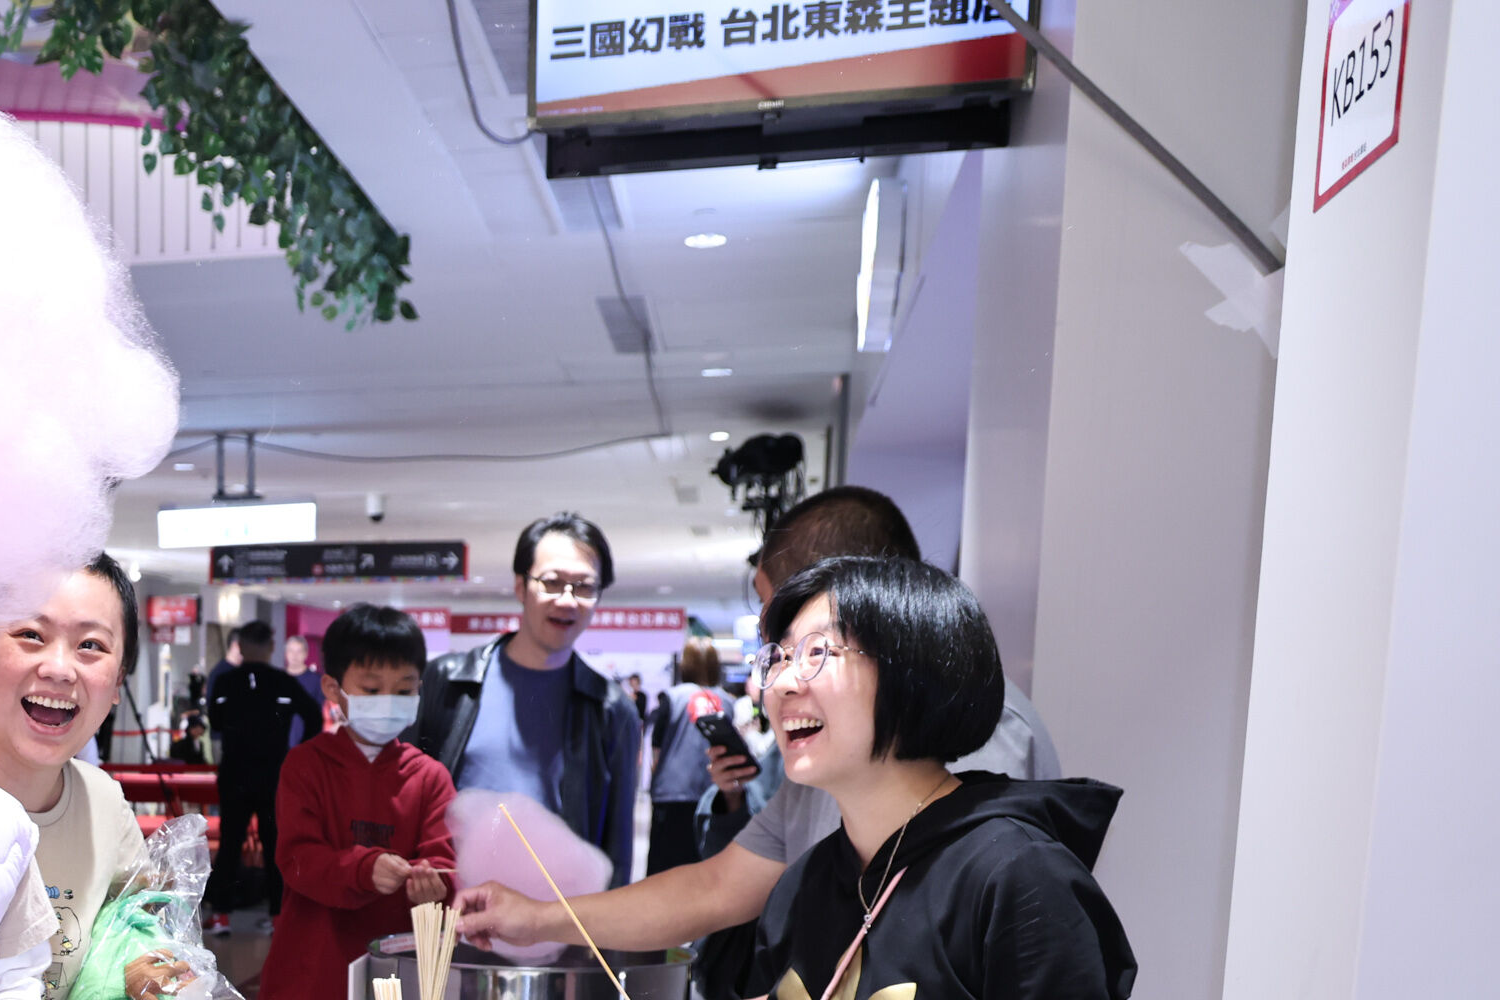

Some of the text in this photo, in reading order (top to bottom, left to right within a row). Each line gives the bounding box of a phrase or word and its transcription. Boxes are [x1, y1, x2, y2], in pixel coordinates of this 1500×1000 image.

[550, 13, 705, 60] 三國幻戰
[1330, 9, 1395, 127] KB153
